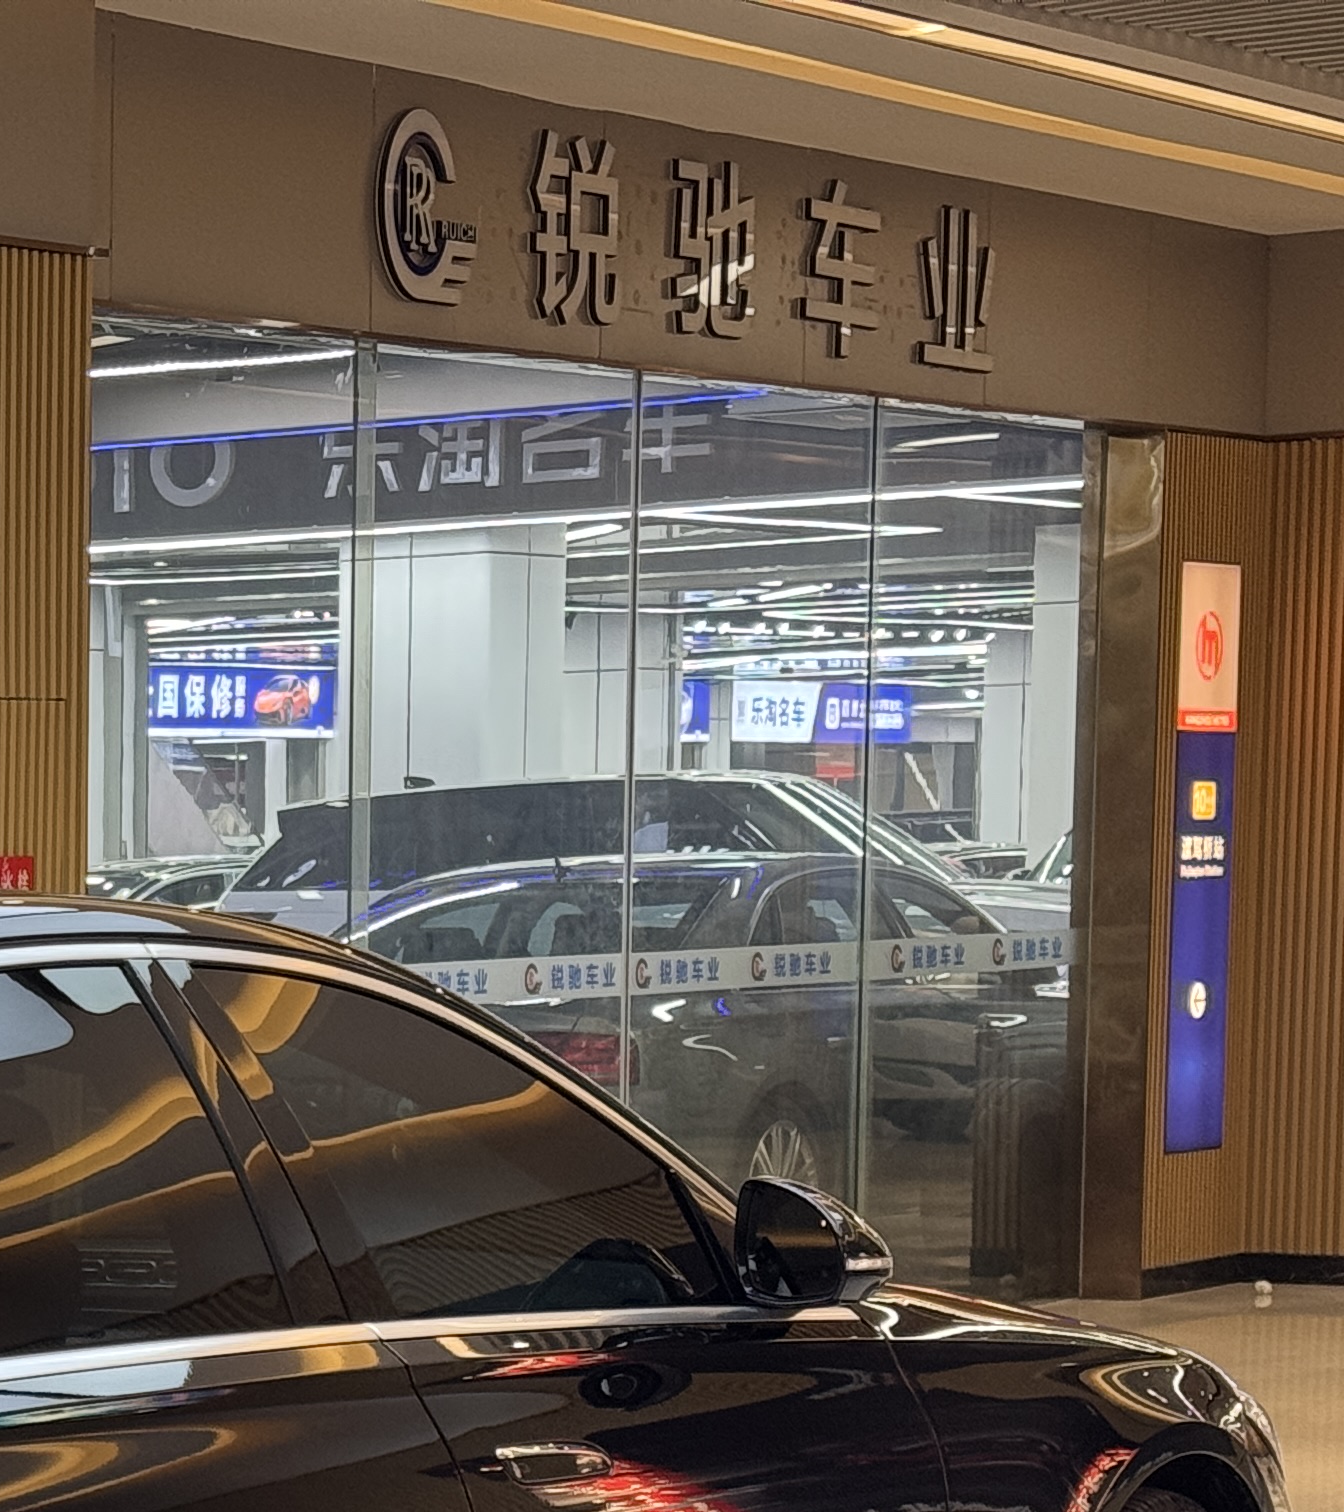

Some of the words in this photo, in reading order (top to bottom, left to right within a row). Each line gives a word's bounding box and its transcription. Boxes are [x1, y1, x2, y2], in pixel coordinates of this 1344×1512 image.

[529, 128, 995, 373] 锐驰车业
[148, 673, 234, 719] 国保修
[551, 961, 617, 991] 锐驰车业
[659, 955, 721, 985] 锐驰车业
[774, 950, 832, 978] 锐驰车业
